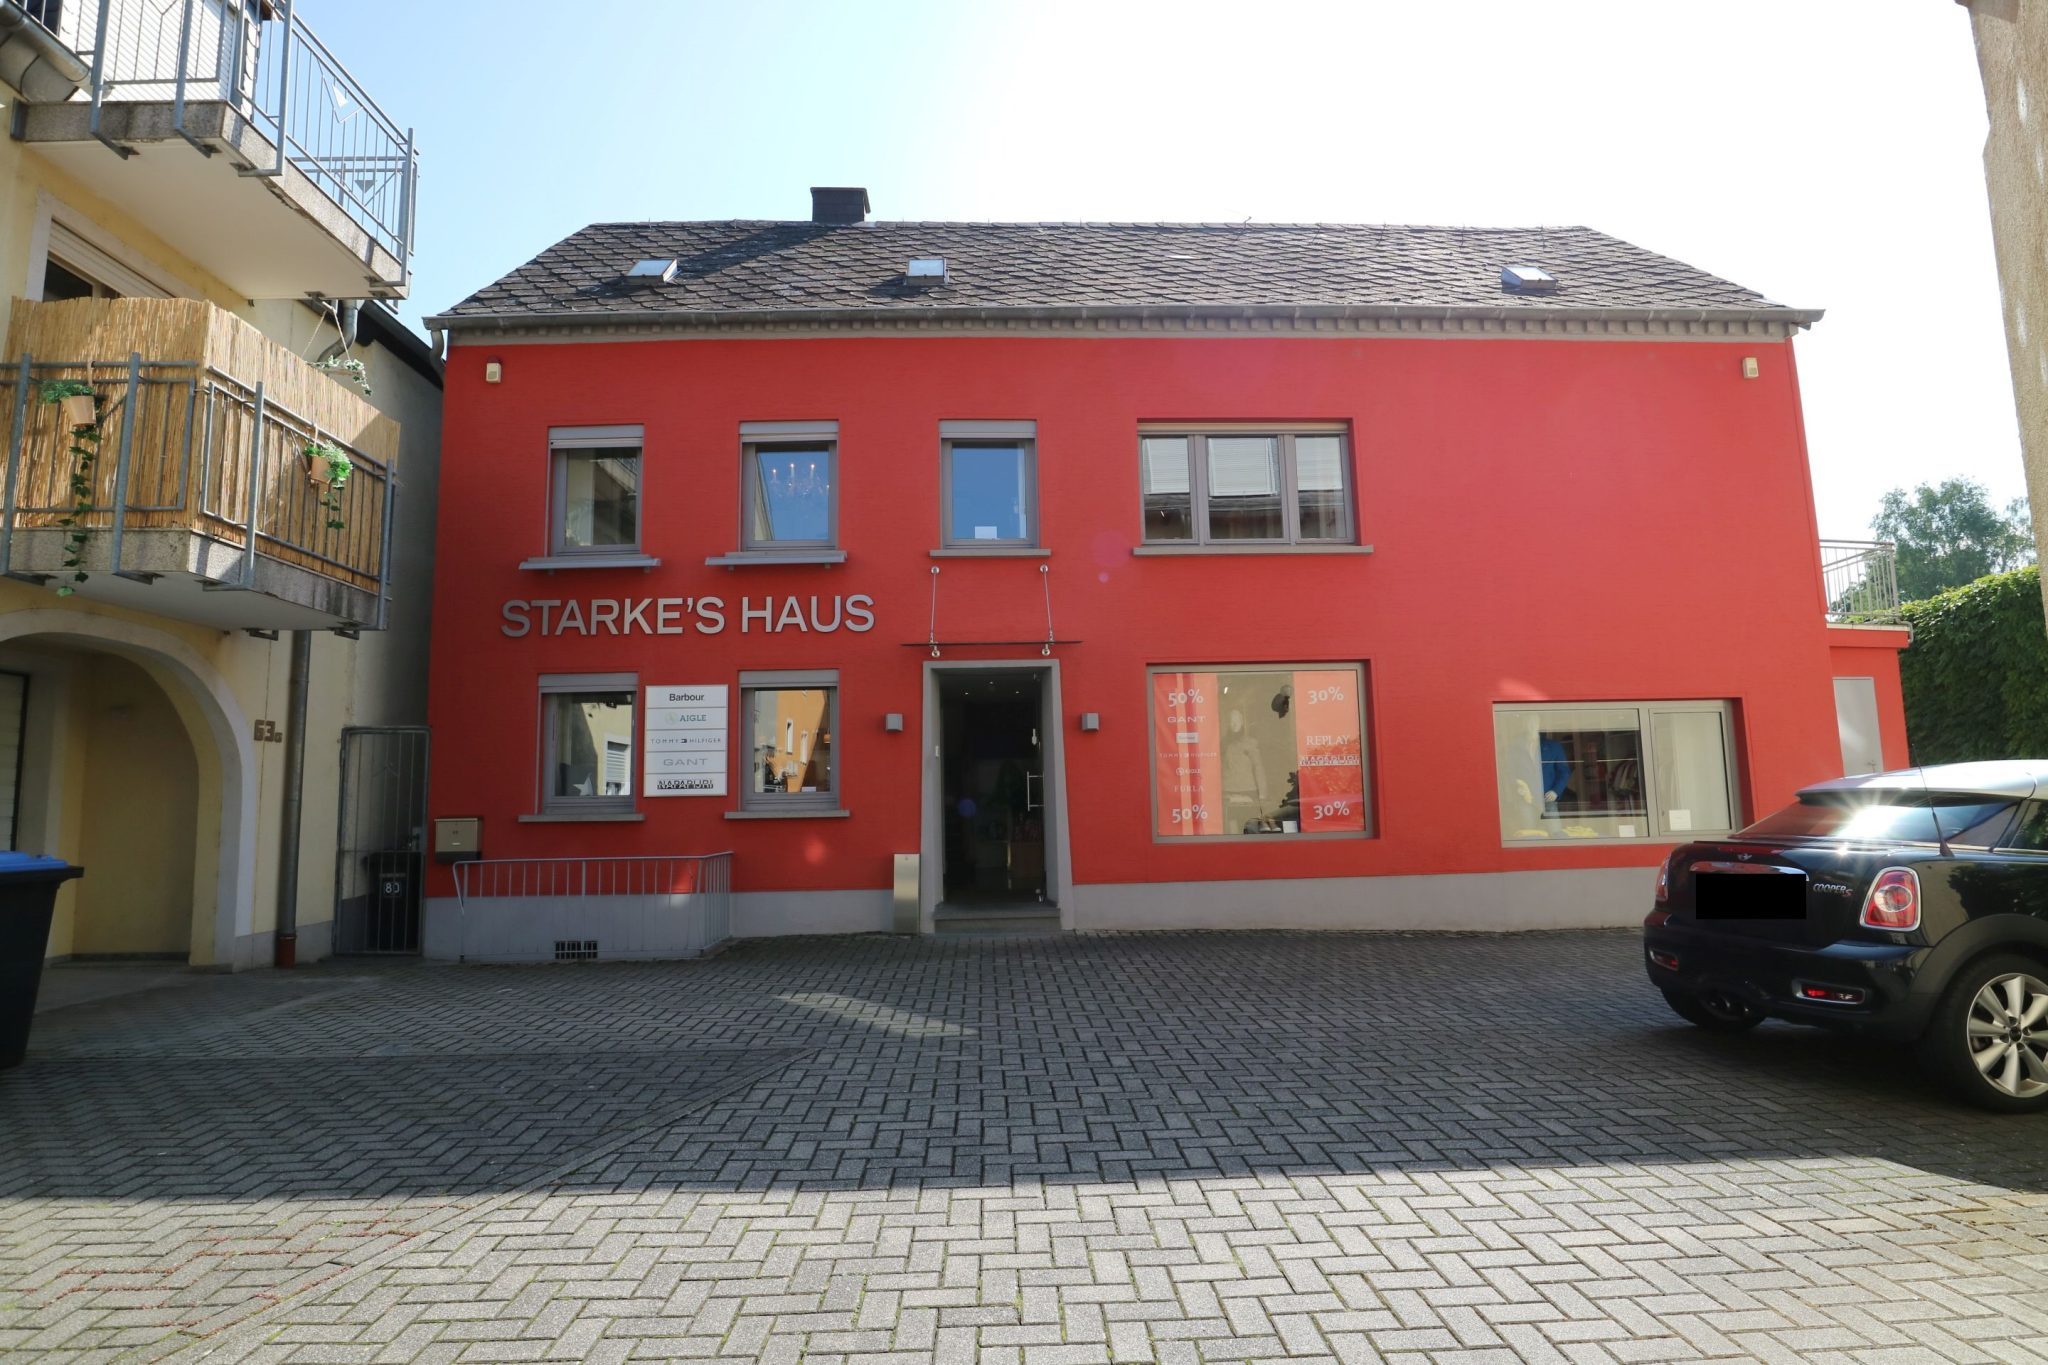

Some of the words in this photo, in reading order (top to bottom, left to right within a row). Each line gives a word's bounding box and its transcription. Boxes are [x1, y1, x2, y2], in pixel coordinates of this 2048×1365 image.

[501, 597, 725, 638] STARKE'S
[741, 594, 875, 633] HAUS
[669, 693, 705, 702] Barbour
[1168, 688, 1205, 708] 50%
[1307, 686, 1345, 705] 30%
[680, 714, 707, 722] AIGLE
[1167, 715, 1207, 723] GANT
[1306, 735, 1350, 746] REPLAY
[663, 758, 708, 767] GANT
[1171, 804, 1208, 824] 50%
[1313, 800, 1350, 820] 30%
[1813, 883, 1847, 894] COOPER
